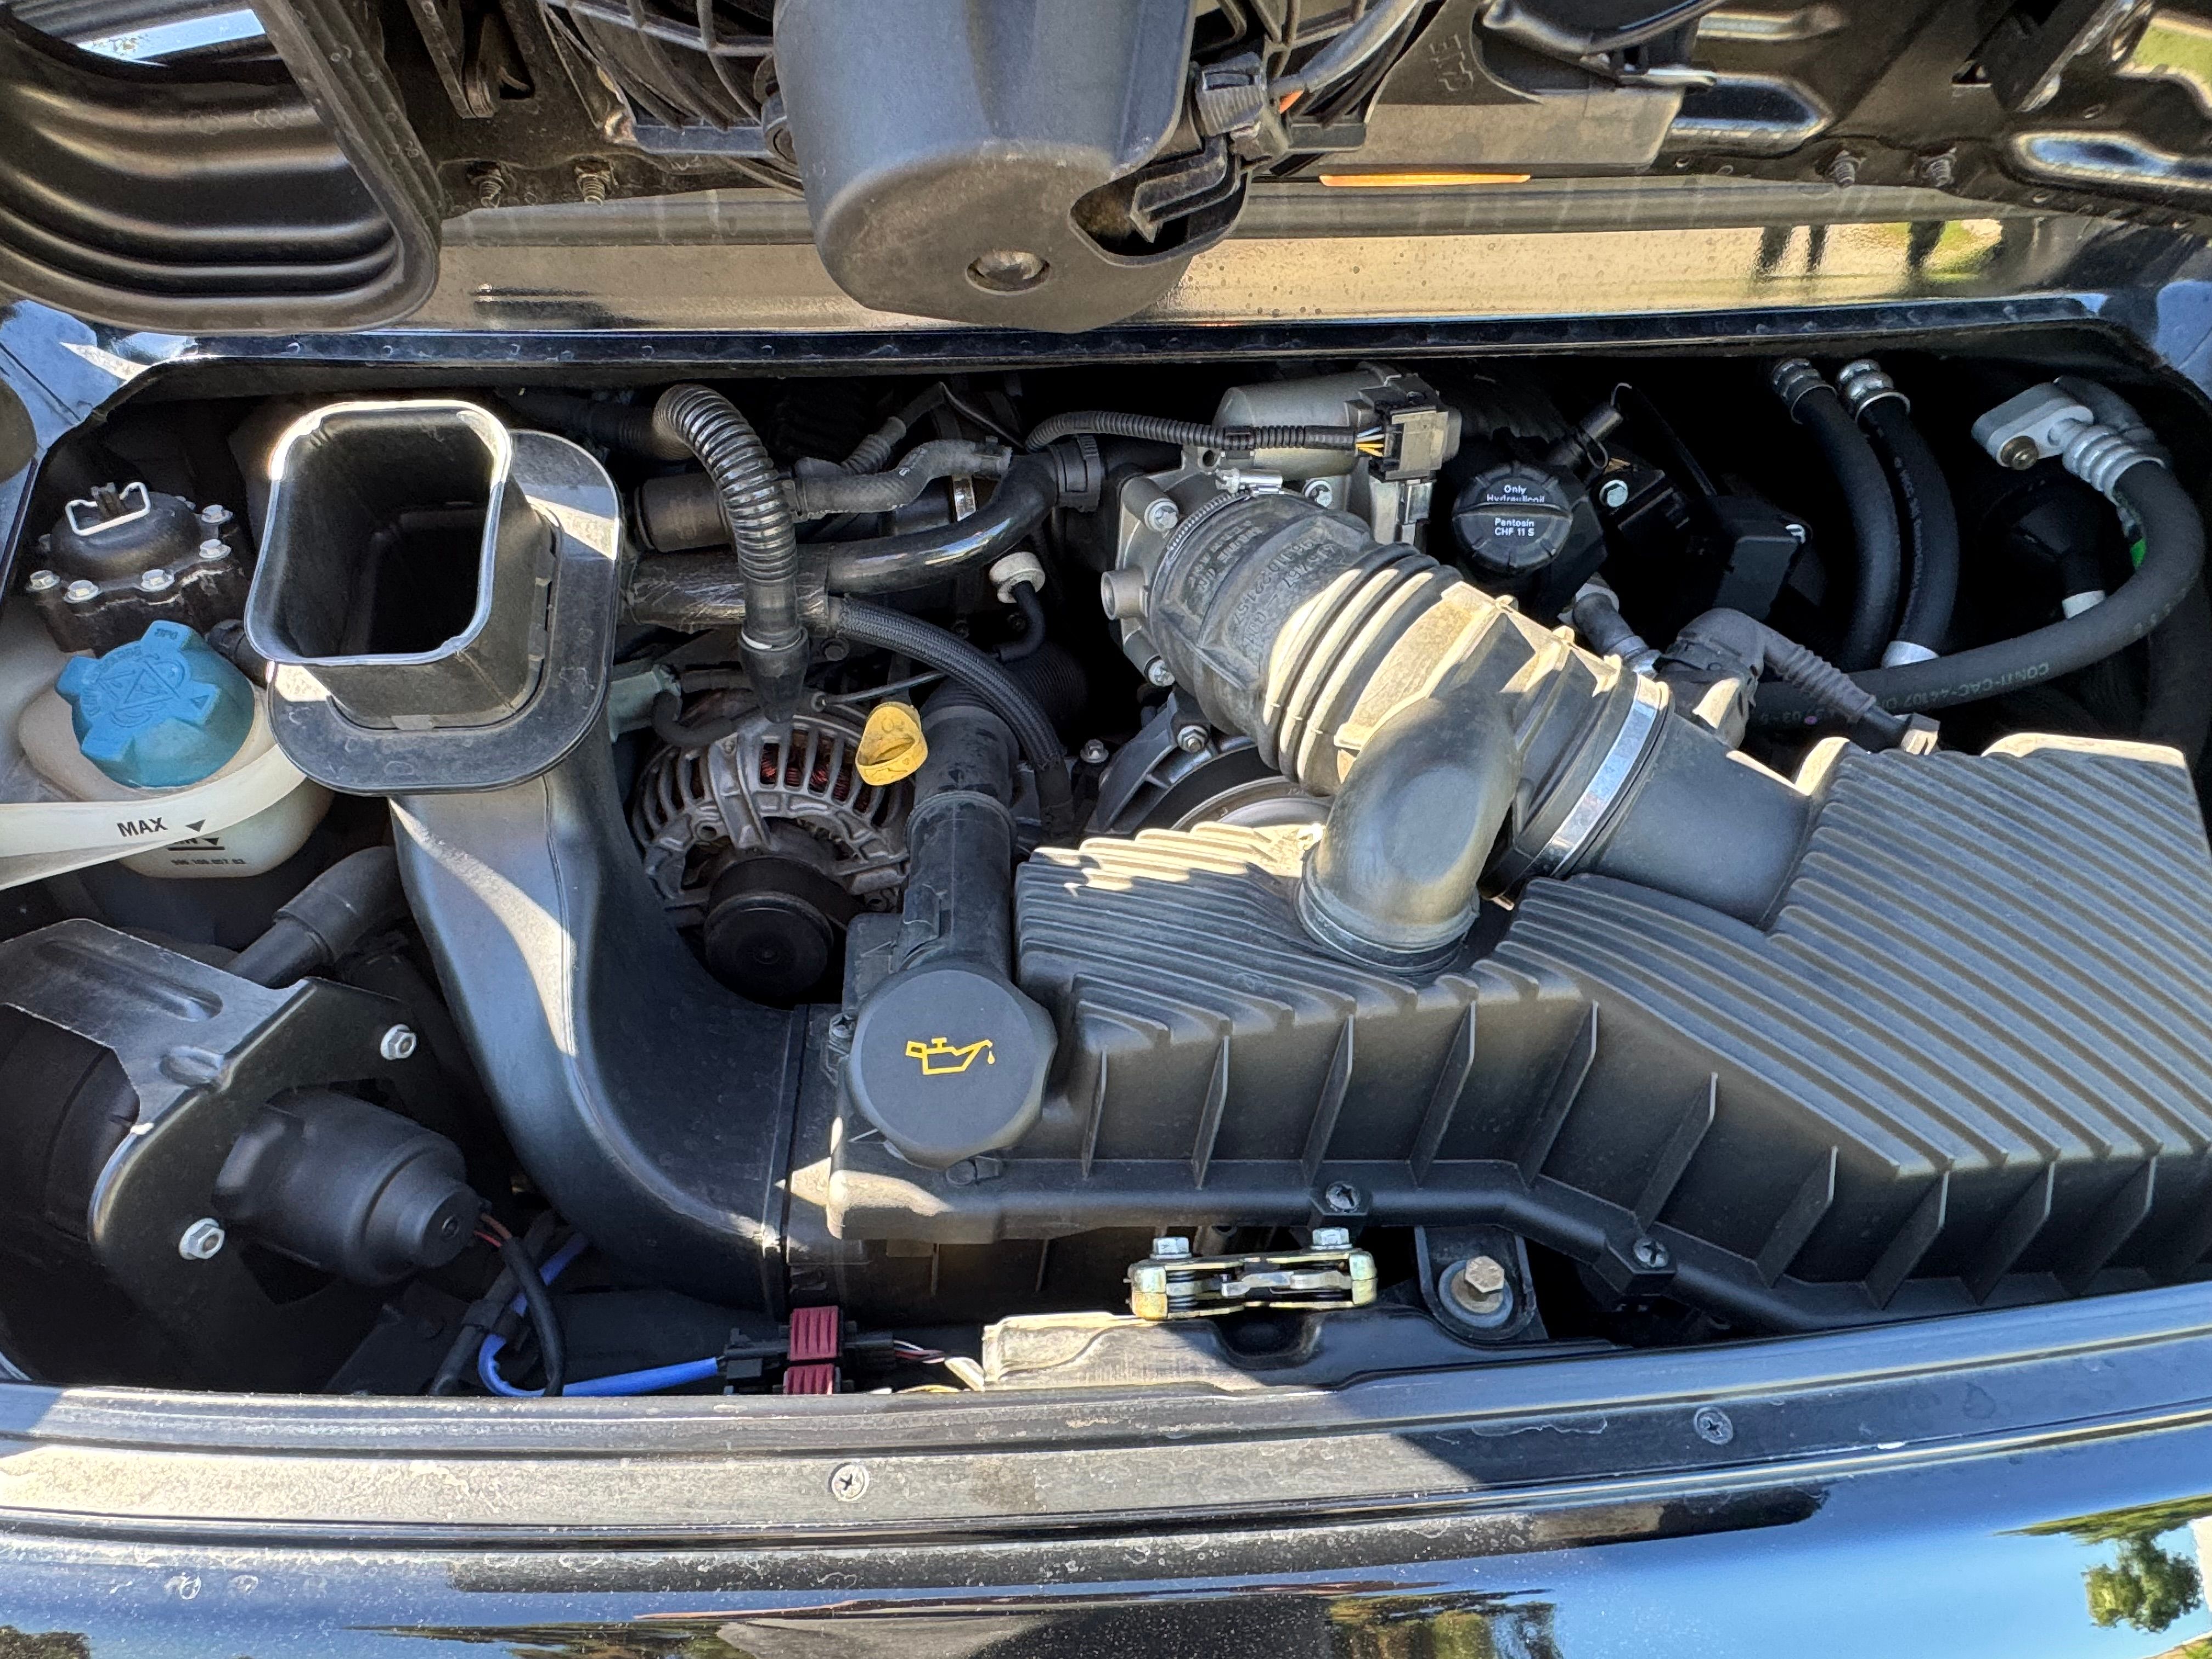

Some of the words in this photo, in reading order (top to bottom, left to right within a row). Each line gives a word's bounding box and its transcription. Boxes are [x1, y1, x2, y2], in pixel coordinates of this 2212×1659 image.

[1504, 484, 1527, 494] Only
[1494, 517, 1534, 527] Pentosin
[1494, 527, 1514, 537] CHF
[1517, 528, 1525, 537] 11
[1527, 528, 1535, 537] S
[116, 817, 168, 837] MAX
